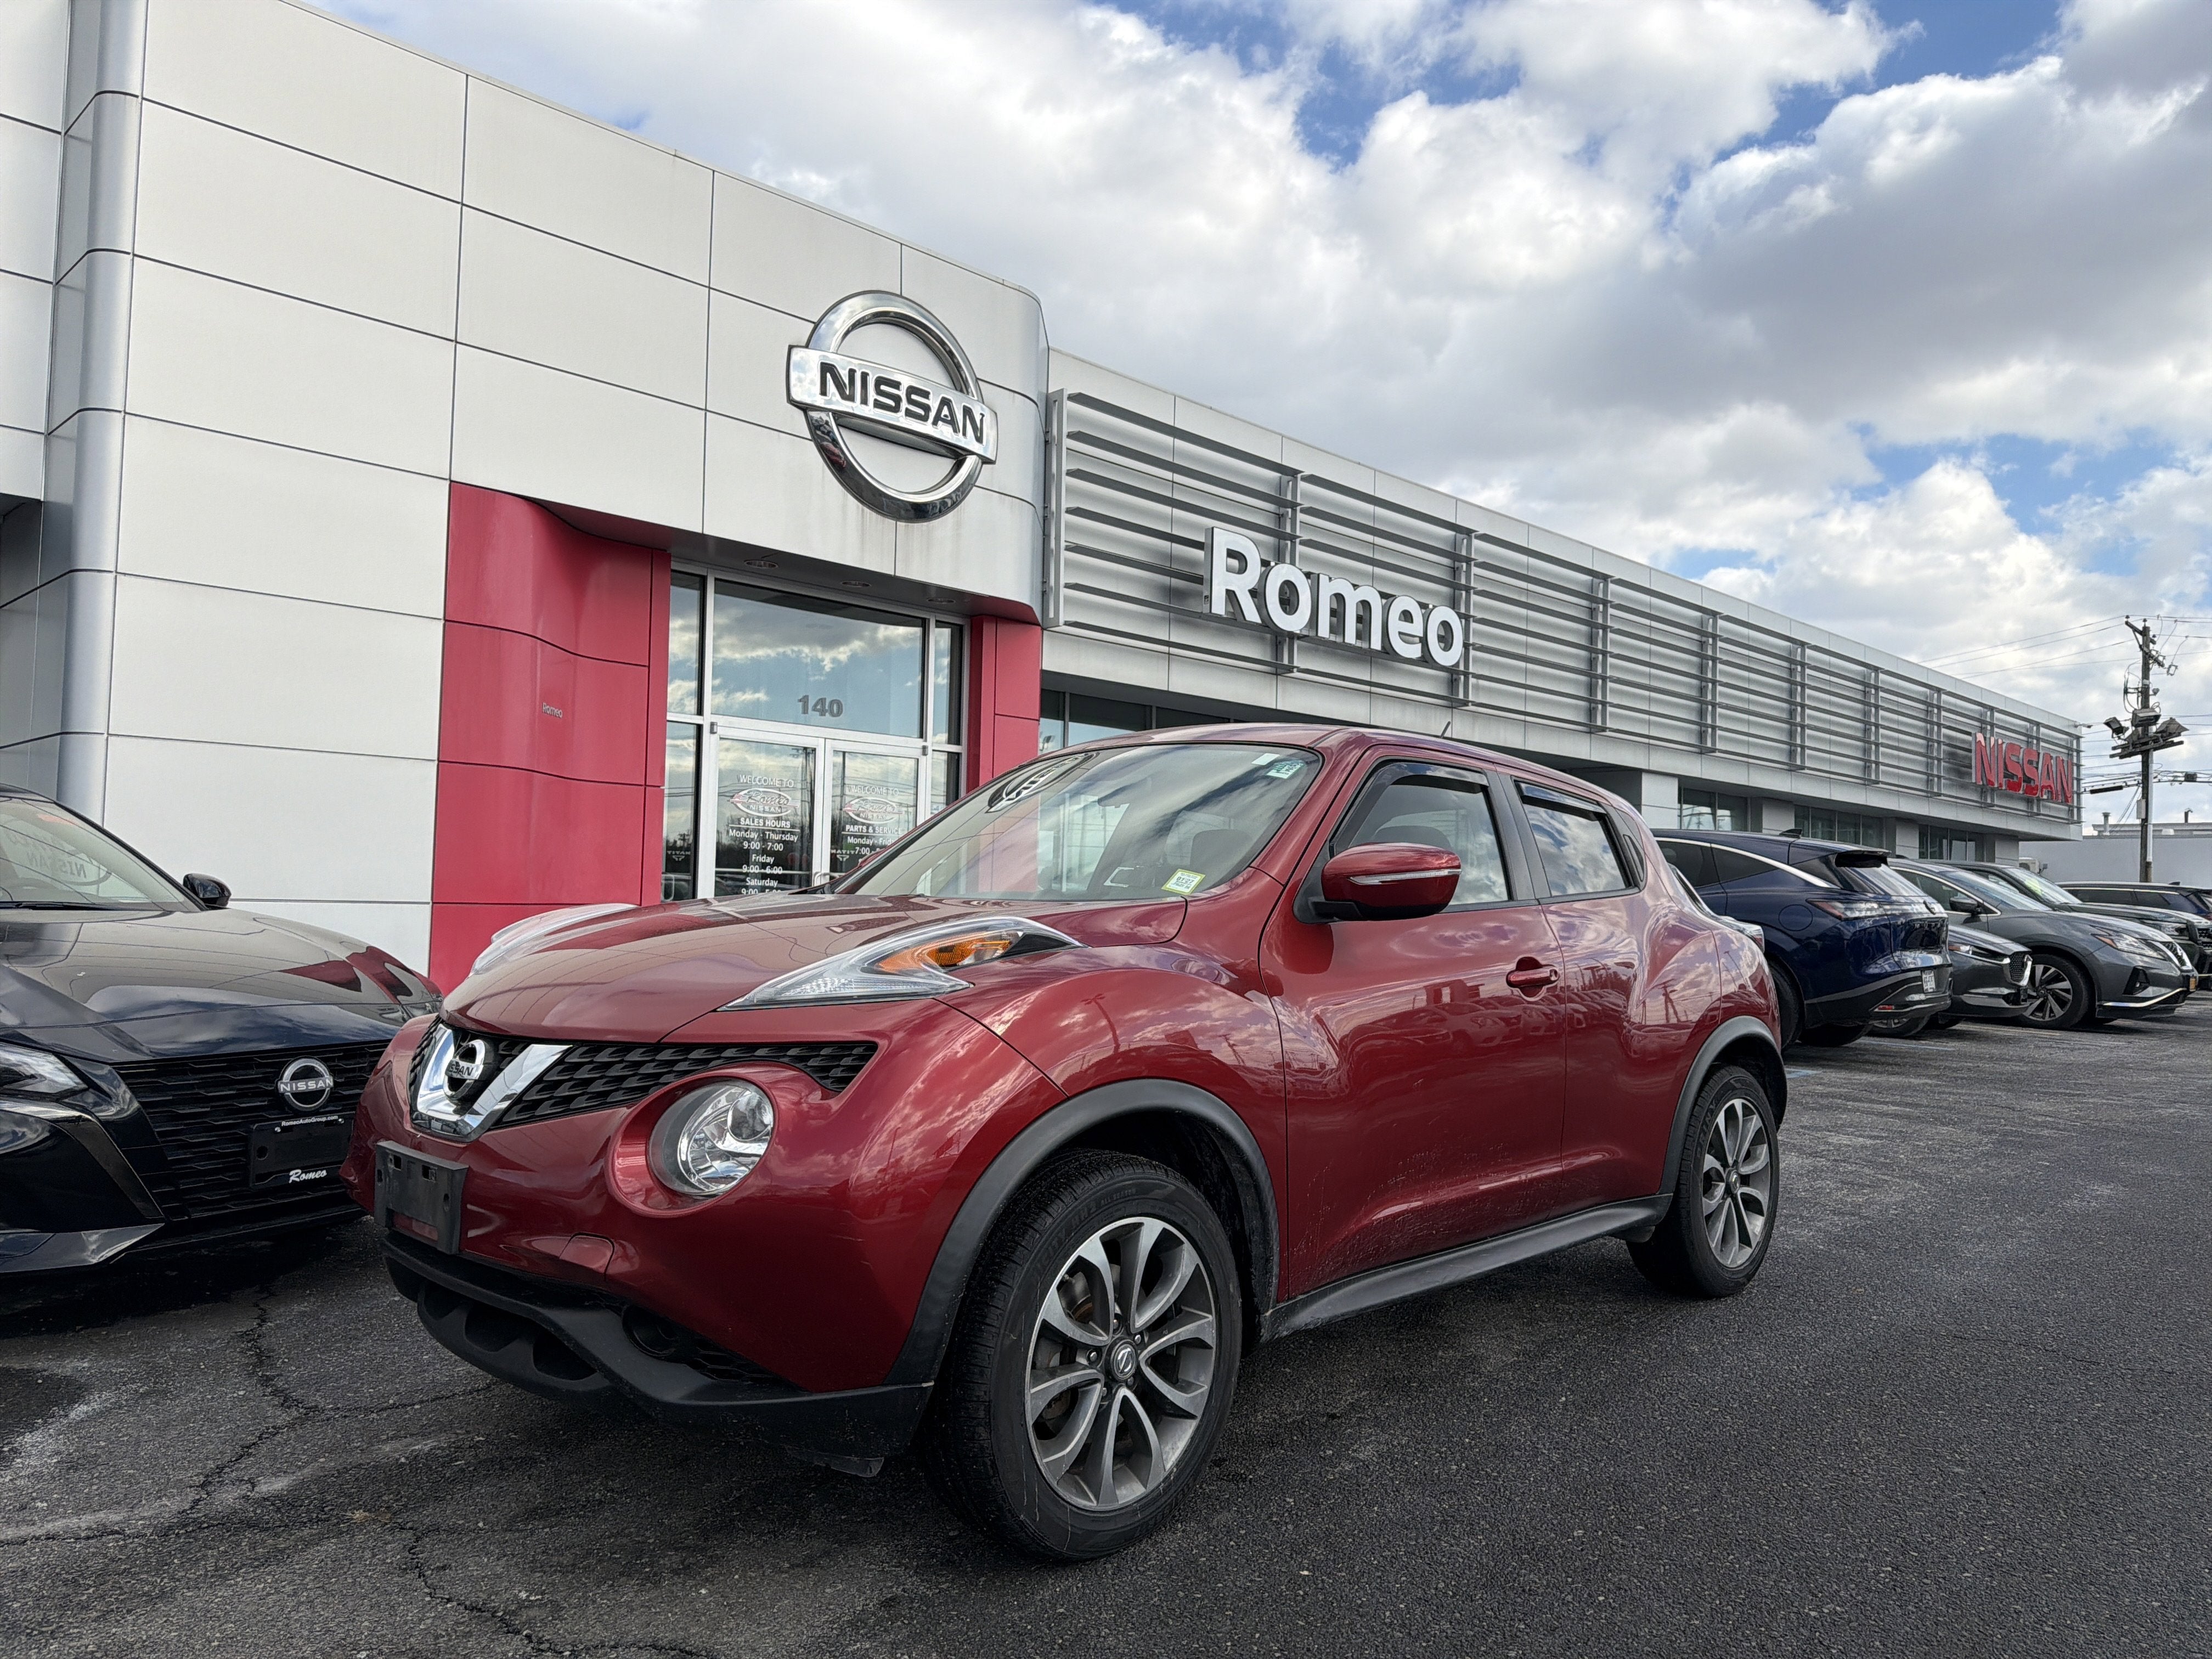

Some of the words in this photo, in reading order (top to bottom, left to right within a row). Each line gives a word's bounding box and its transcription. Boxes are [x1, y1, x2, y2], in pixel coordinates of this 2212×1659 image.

[819, 360, 985, 445] NISSAN
[1205, 527, 1464, 667] Romeo
[543, 702, 563, 718] Romeo
[797, 695, 843, 718] 140
[1973, 732, 2072, 804] NISSAN
[740, 775, 782, 786] WELCOME
[783, 779, 794, 788] TO
[750, 804, 781, 813] NISSAN
[740, 817, 764, 826] SALES
[765, 819, 791, 828] HOURS
[845, 825, 867, 833] PARTS
[729, 829, 759, 840] Monday
[764, 831, 798, 842] Thursday
[848, 836, 873, 846] Monday
[743, 841, 760, 850] 9:00
[767, 842, 783, 851] 7:00
[752, 854, 775, 864] Friday
[742, 865, 759, 873] 9:00
[766, 866, 783, 874] 6:00
[746, 877, 778, 888] Saturday
[280, 1079, 333, 1092] NISSAN
[281, 1115, 338, 1127] RomeoAutoGroup.com
[289, 1169, 327, 1183] Romeo
